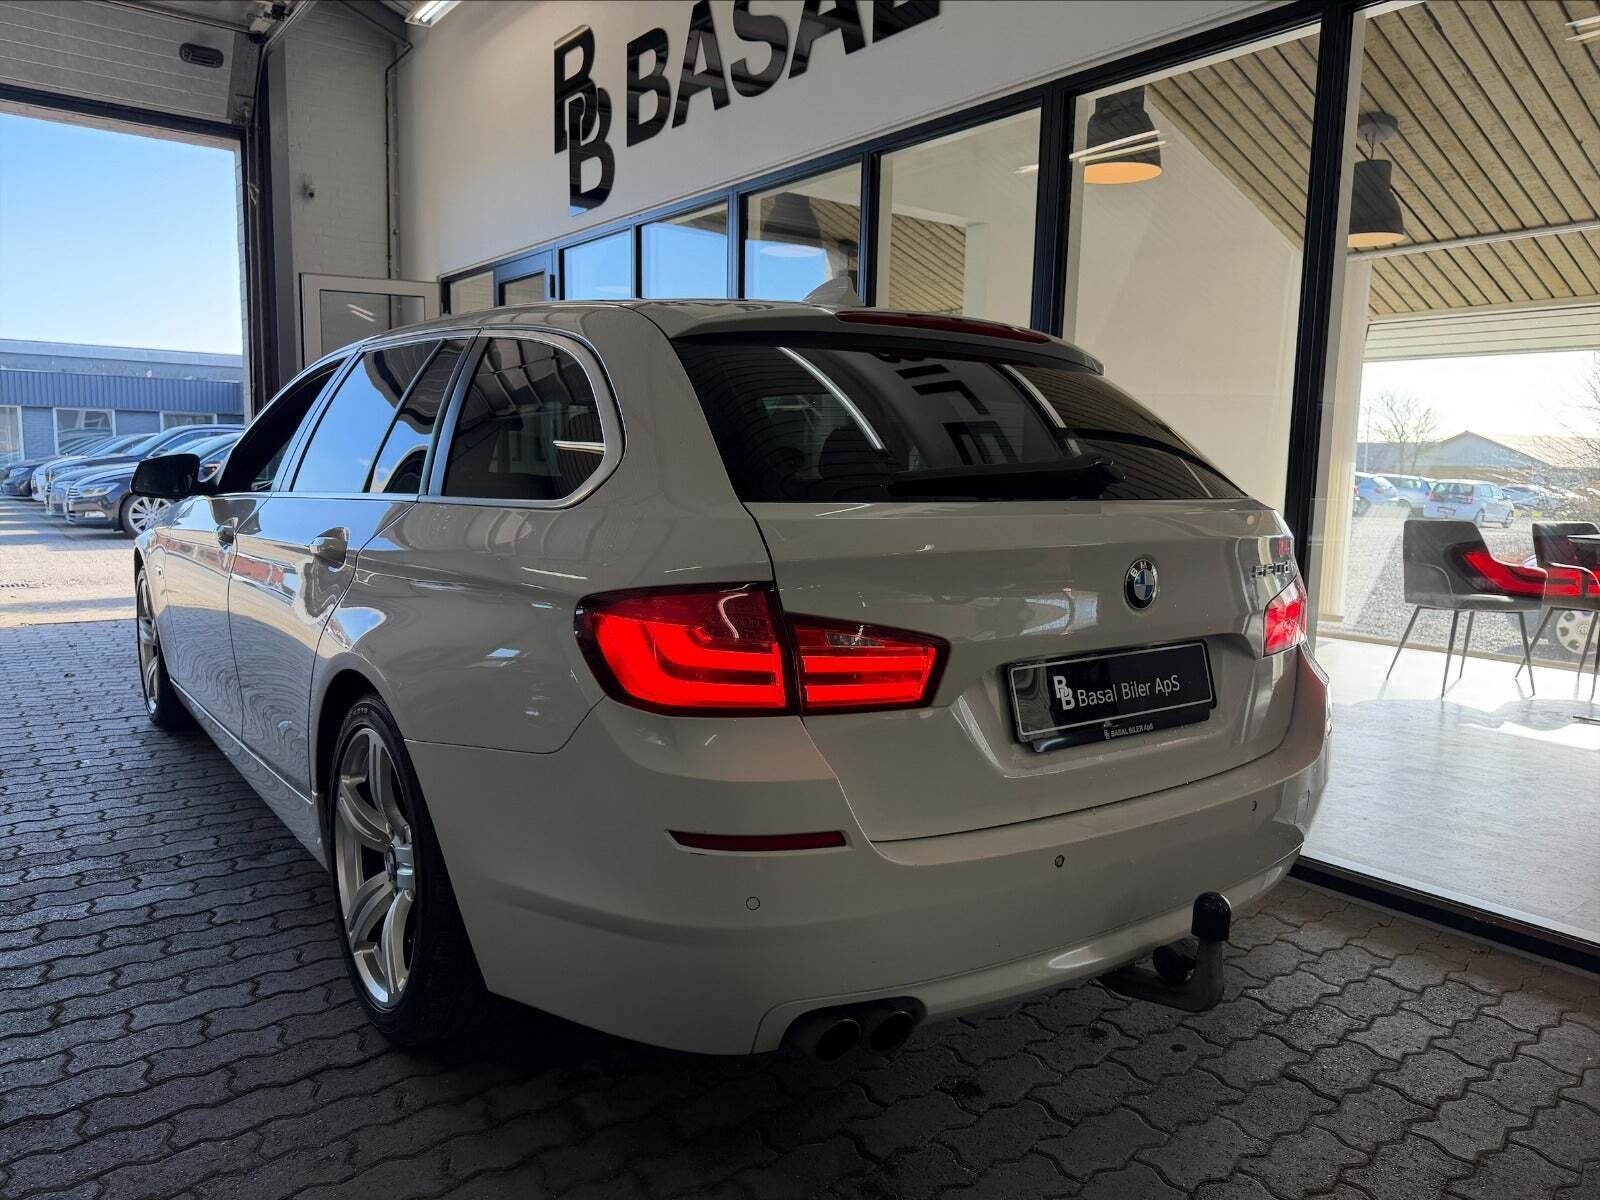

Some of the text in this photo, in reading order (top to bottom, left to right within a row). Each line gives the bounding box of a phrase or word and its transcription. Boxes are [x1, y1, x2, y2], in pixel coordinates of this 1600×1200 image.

[1078, 684, 1118, 707] Basal
[1121, 682, 1150, 701] Biler
[1155, 674, 1181, 697] ApS
